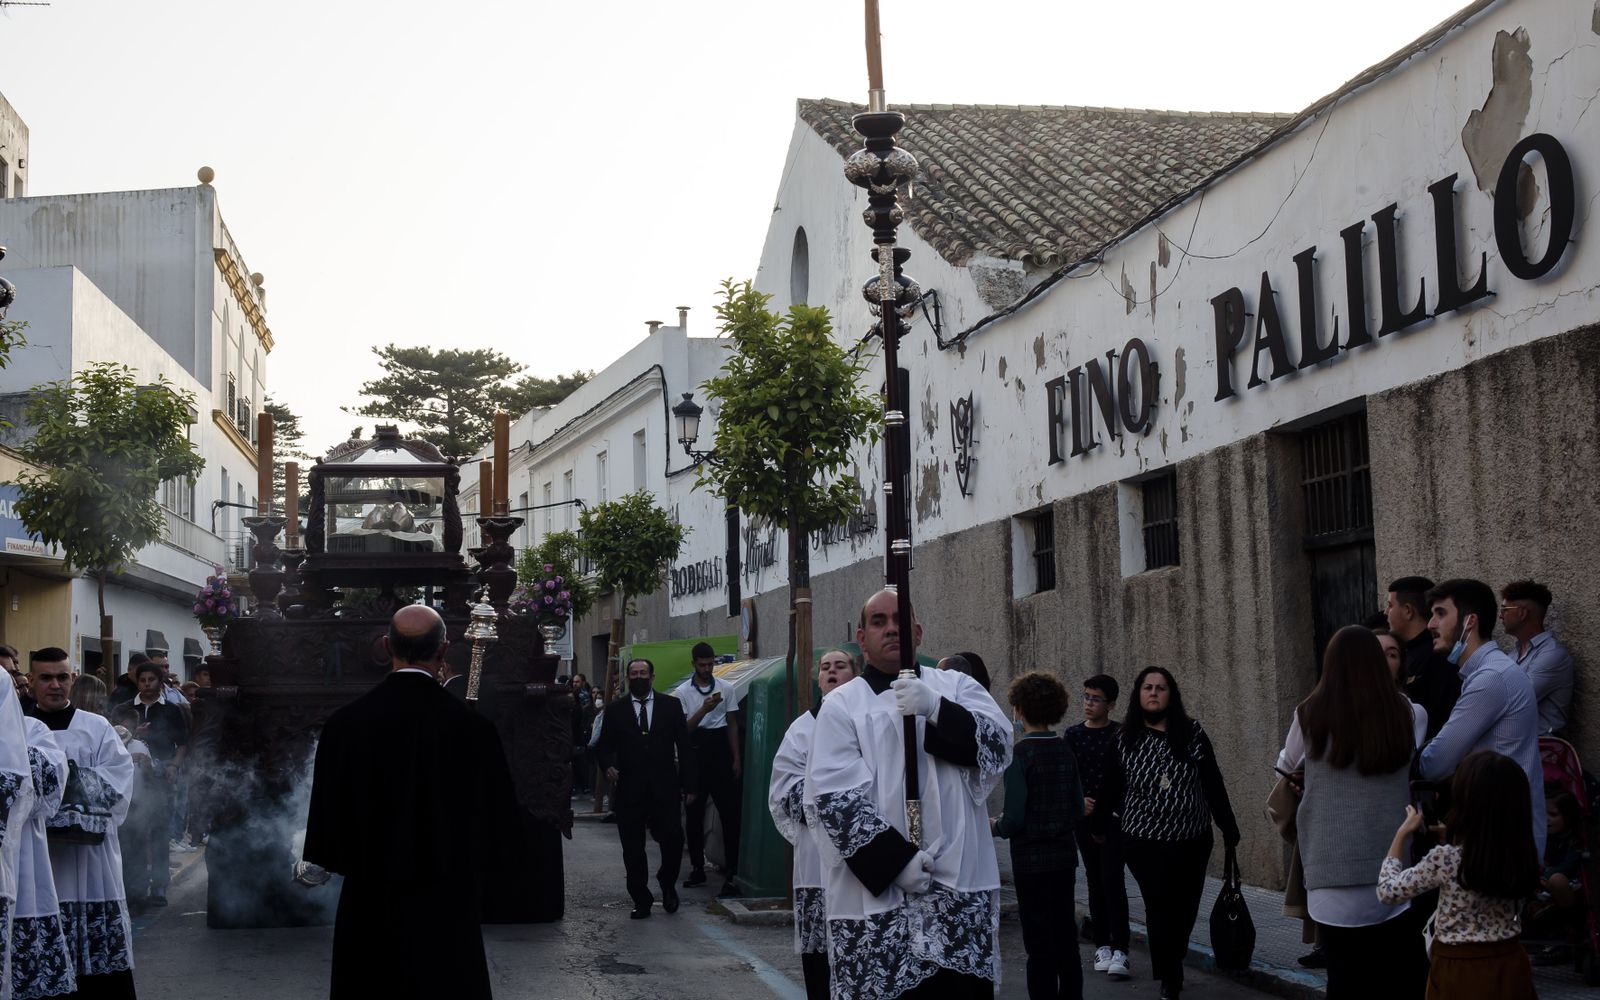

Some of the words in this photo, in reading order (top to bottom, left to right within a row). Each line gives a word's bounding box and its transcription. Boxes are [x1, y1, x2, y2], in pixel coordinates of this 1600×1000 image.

[1045, 337, 1152, 466] FINO
[1210, 133, 1575, 402] PALILLO
[672, 556, 722, 598] BODEGAS
